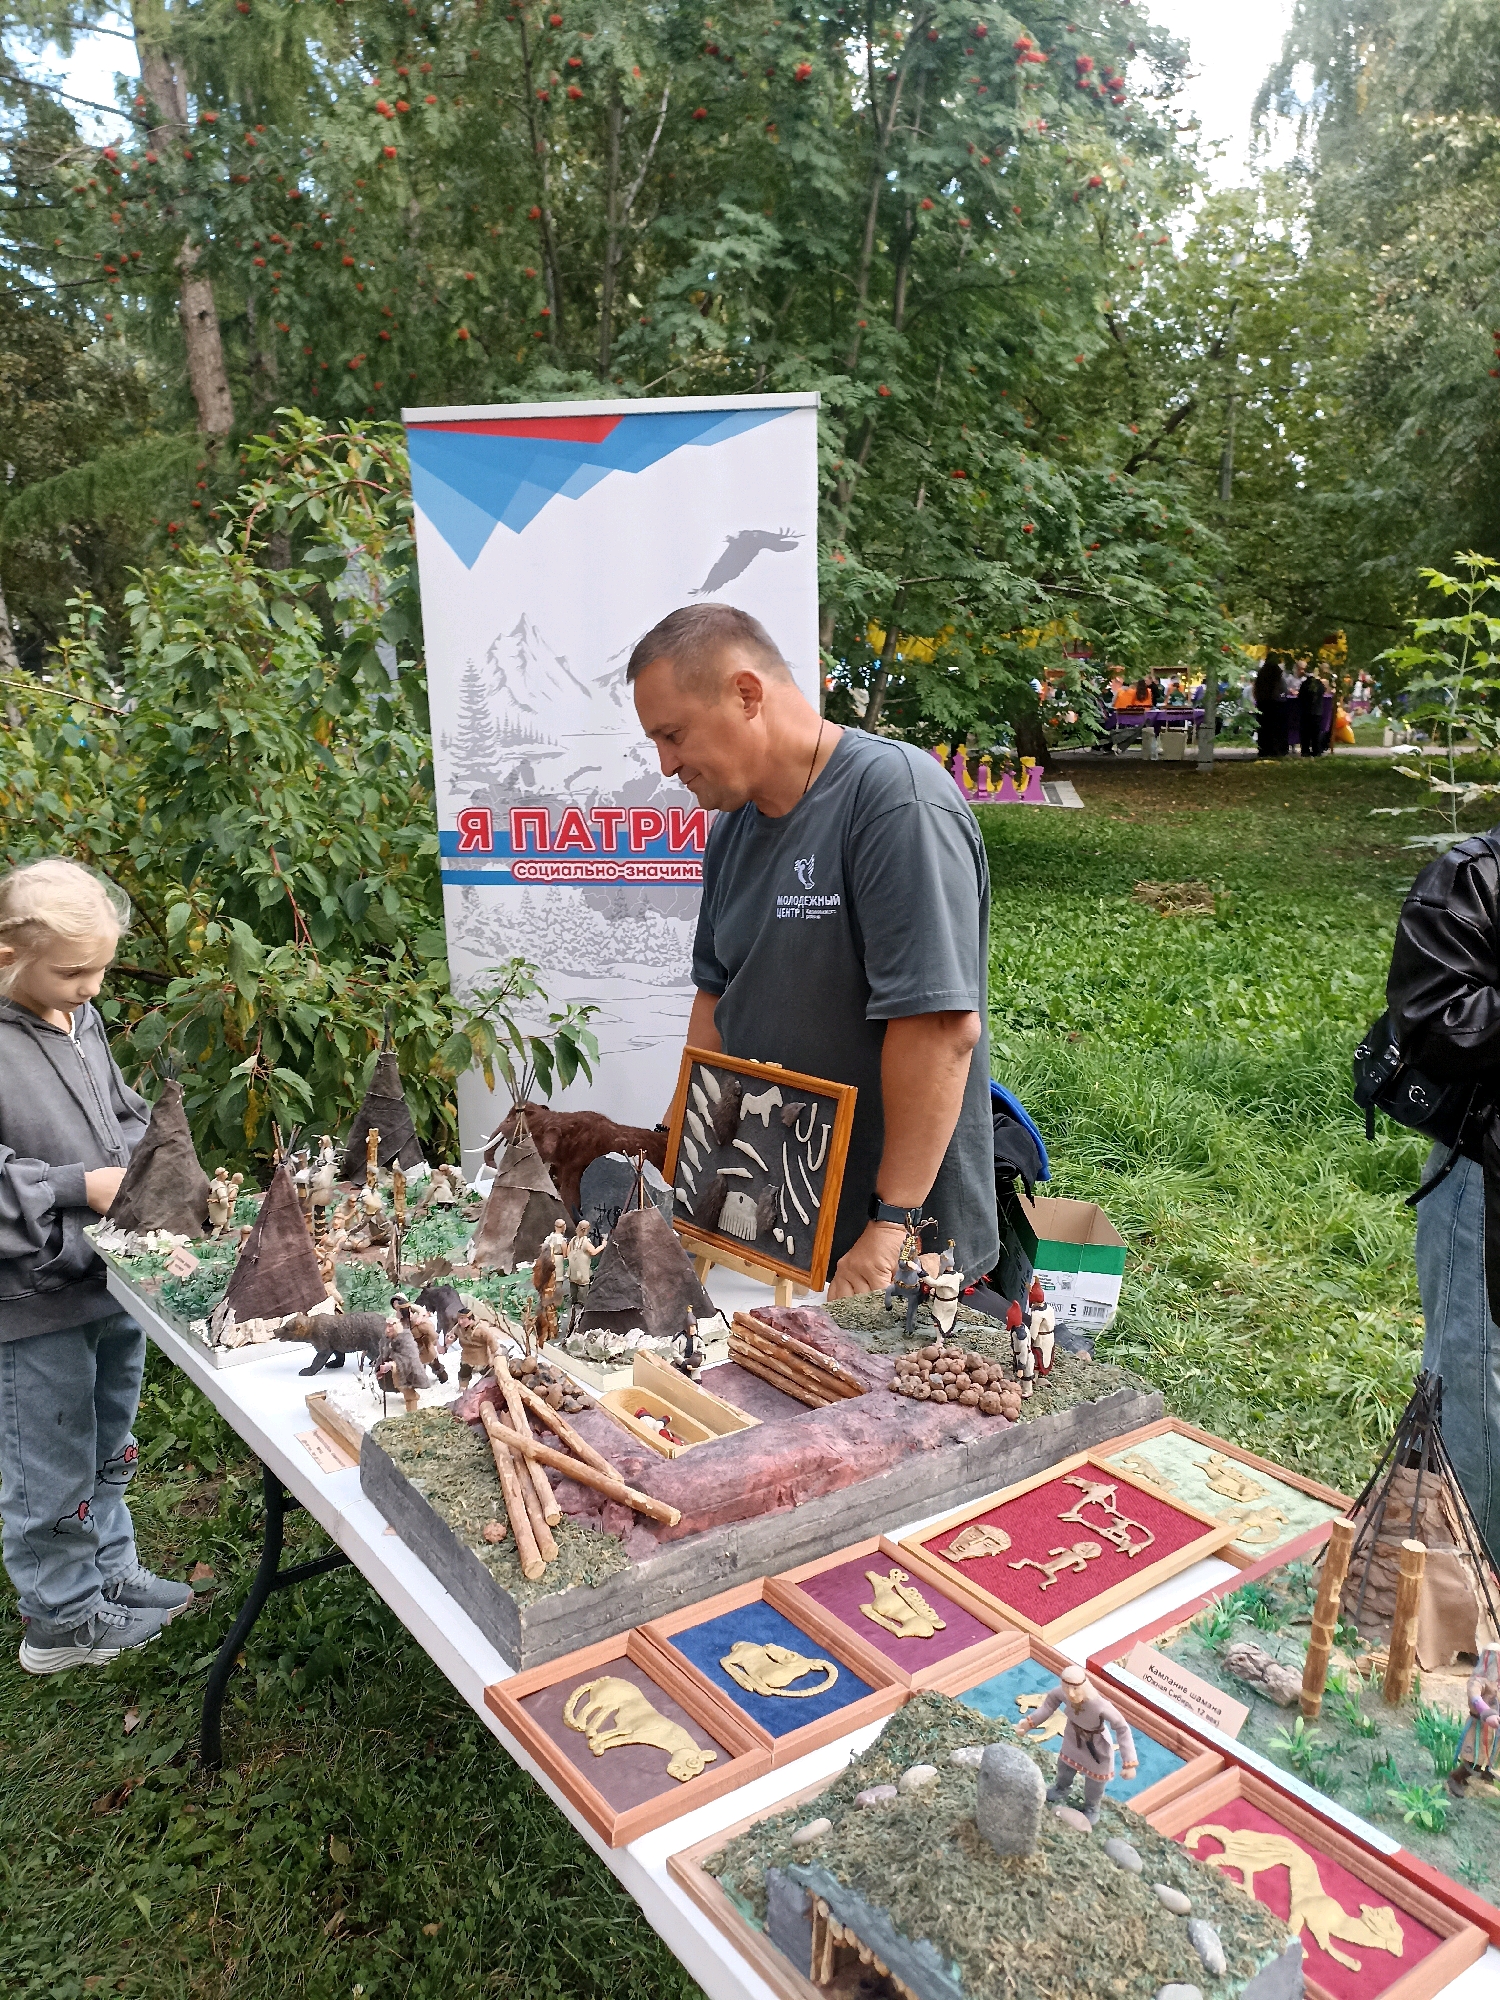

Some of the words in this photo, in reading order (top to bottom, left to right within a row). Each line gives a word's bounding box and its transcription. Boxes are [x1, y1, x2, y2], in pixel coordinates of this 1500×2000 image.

[457, 807, 493, 852] Я
[509, 806, 712, 854] ПАТРИ
[776, 893, 841, 908] МОЛОДЕЖНЫЙ
[776, 907, 801, 919] ЦЕНТР
[1142, 1673, 1168, 1692] (Южная
[1148, 1664, 1188, 1694] Камлание
[1189, 1692, 1222, 1716] шамана
